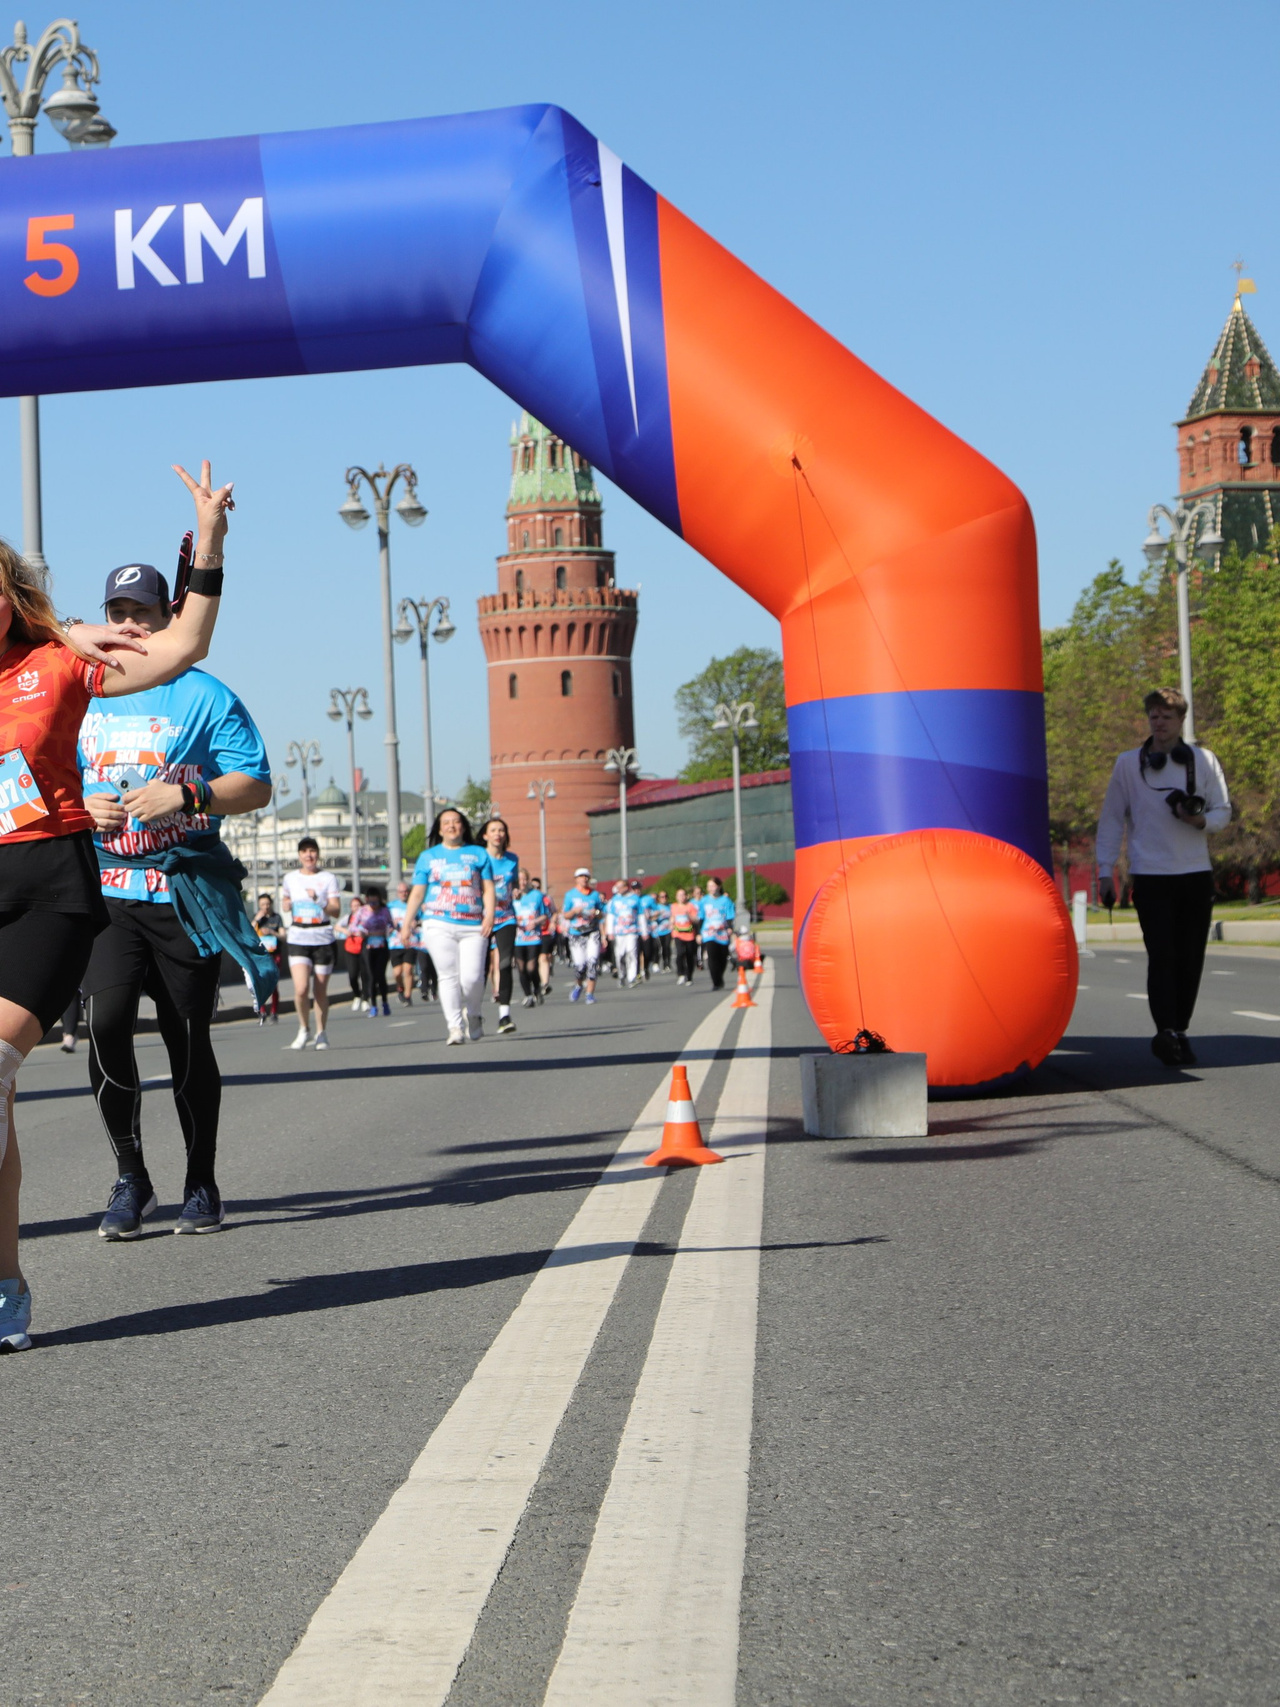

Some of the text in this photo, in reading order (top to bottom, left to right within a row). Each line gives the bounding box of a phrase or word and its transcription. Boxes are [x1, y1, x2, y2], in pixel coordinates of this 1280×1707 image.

[23, 213, 80, 298] 5
[114, 197, 267, 290] КМ
[18, 678, 40, 689] ПСБ
[12, 690, 48, 703] СПОРТ
[21, 776, 29, 787] F
